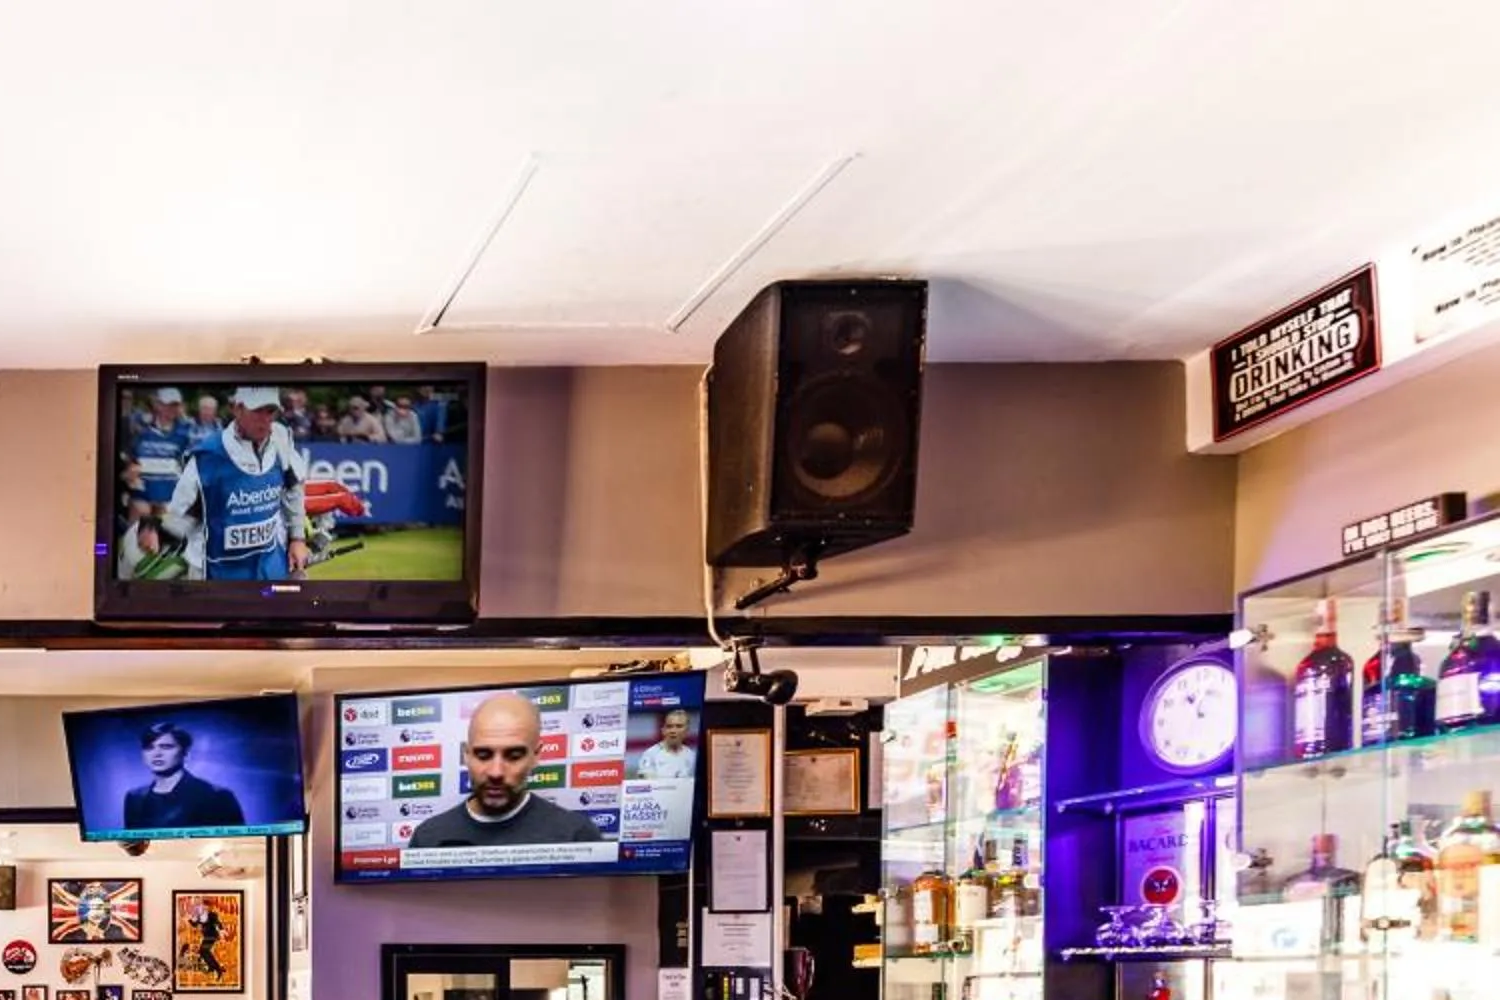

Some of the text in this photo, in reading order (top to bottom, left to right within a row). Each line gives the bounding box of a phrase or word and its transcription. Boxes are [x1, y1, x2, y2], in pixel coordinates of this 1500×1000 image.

[1270, 308, 1317, 341] MYSELF
[1235, 321, 1350, 398] DRINKING
[227, 483, 282, 508] Aberde
[230, 518, 278, 548] STENS
[1128, 833, 1189, 853] BACARD
